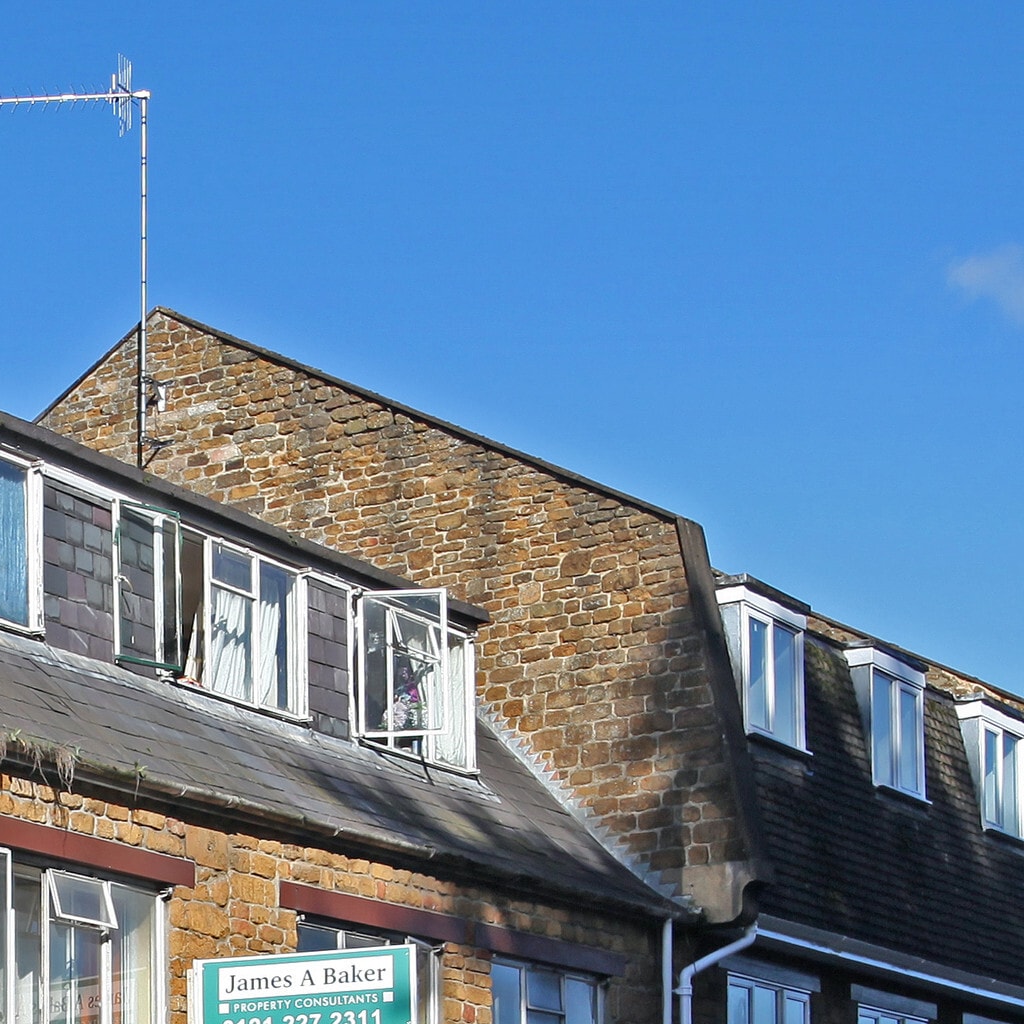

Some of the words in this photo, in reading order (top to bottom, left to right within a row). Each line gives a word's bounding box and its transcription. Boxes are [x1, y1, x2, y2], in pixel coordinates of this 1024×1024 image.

[225, 974, 293, 994] James
[300, 969, 316, 987] A
[322, 965, 386, 985] Baker
[233, 999, 291, 1013] PROPERTY
[294, 993, 379, 1009] CONSULTANTS
